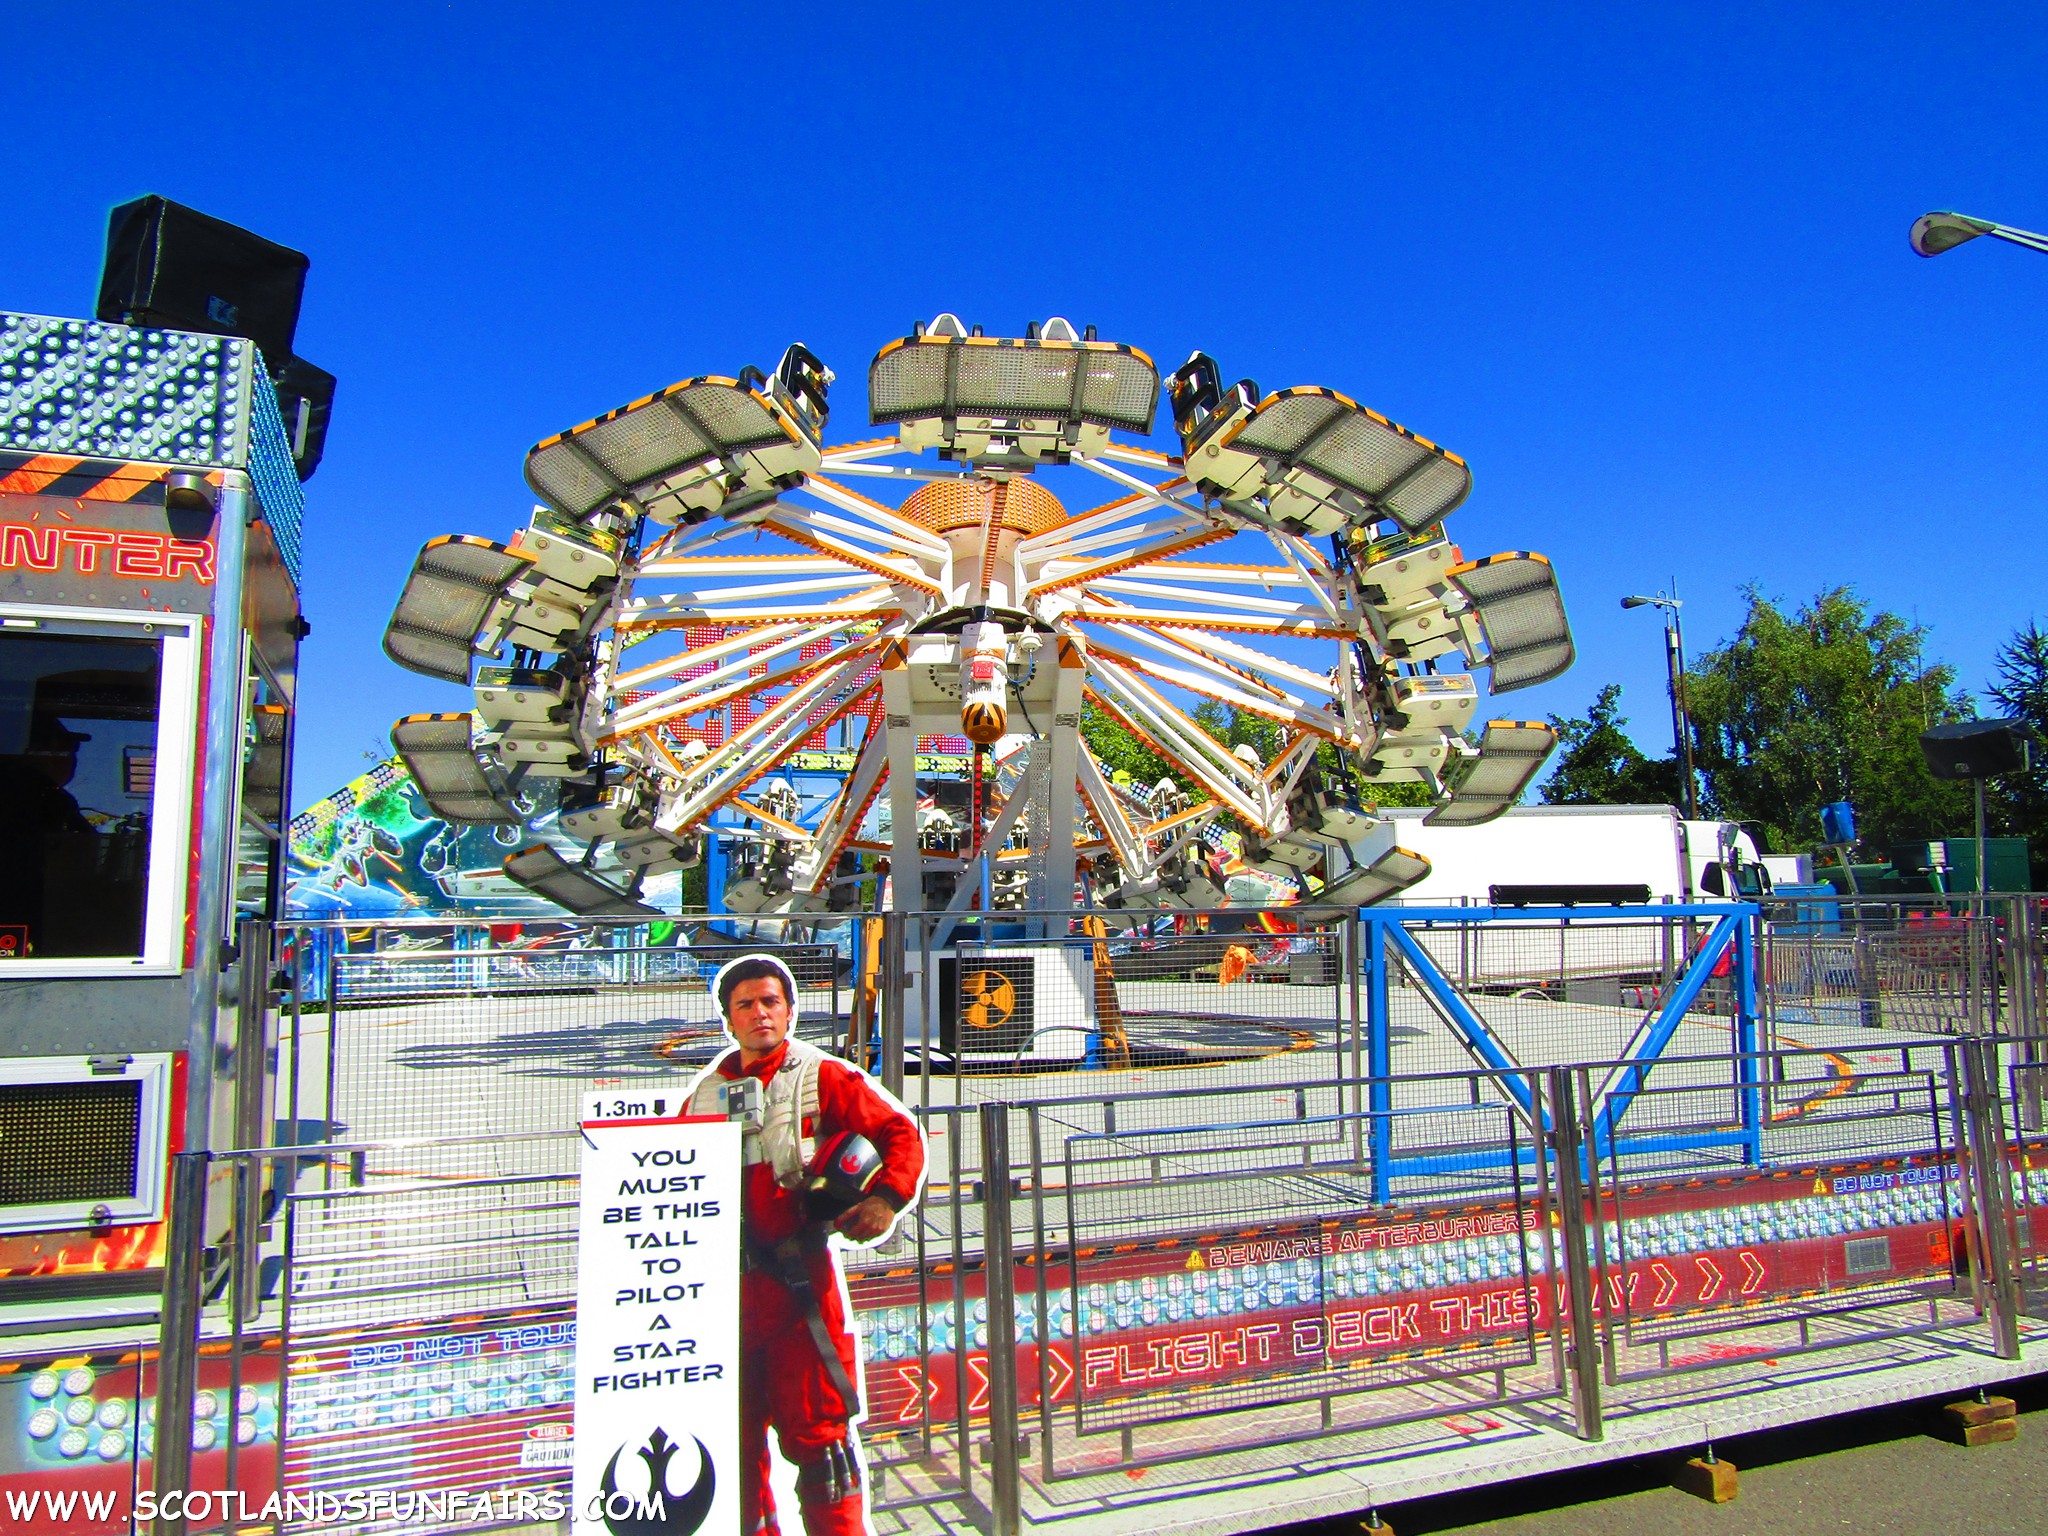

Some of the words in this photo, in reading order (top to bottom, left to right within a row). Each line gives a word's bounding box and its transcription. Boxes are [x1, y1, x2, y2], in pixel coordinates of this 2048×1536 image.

[593, 1100, 647, 1117] 1.3m
[631, 1149, 696, 1168] YOU
[618, 1175, 707, 1196] MUST
[1834, 1176, 1857, 1193] DO
[1860, 1173, 1893, 1190] NOT
[603, 1206, 643, 1224] BE
[652, 1201, 721, 1221] THIS
[624, 1230, 699, 1250] TALL
[1209, 1233, 1332, 1267] BEWARE
[1338, 1209, 1536, 1252] AFTERBURNERS
[641, 1257, 682, 1276] TO
[615, 1282, 706, 1307] PILOT
[648, 1313, 672, 1332] A
[1086, 1323, 1280, 1388] FLIGHT
[1292, 1303, 1420, 1358] DECK
[1429, 1285, 1540, 1334] THIS
[352, 1344, 404, 1368] DO
[413, 1335, 489, 1360] NOT
[613, 1338, 697, 1364] STAR
[593, 1363, 724, 1394] FIGHTER
